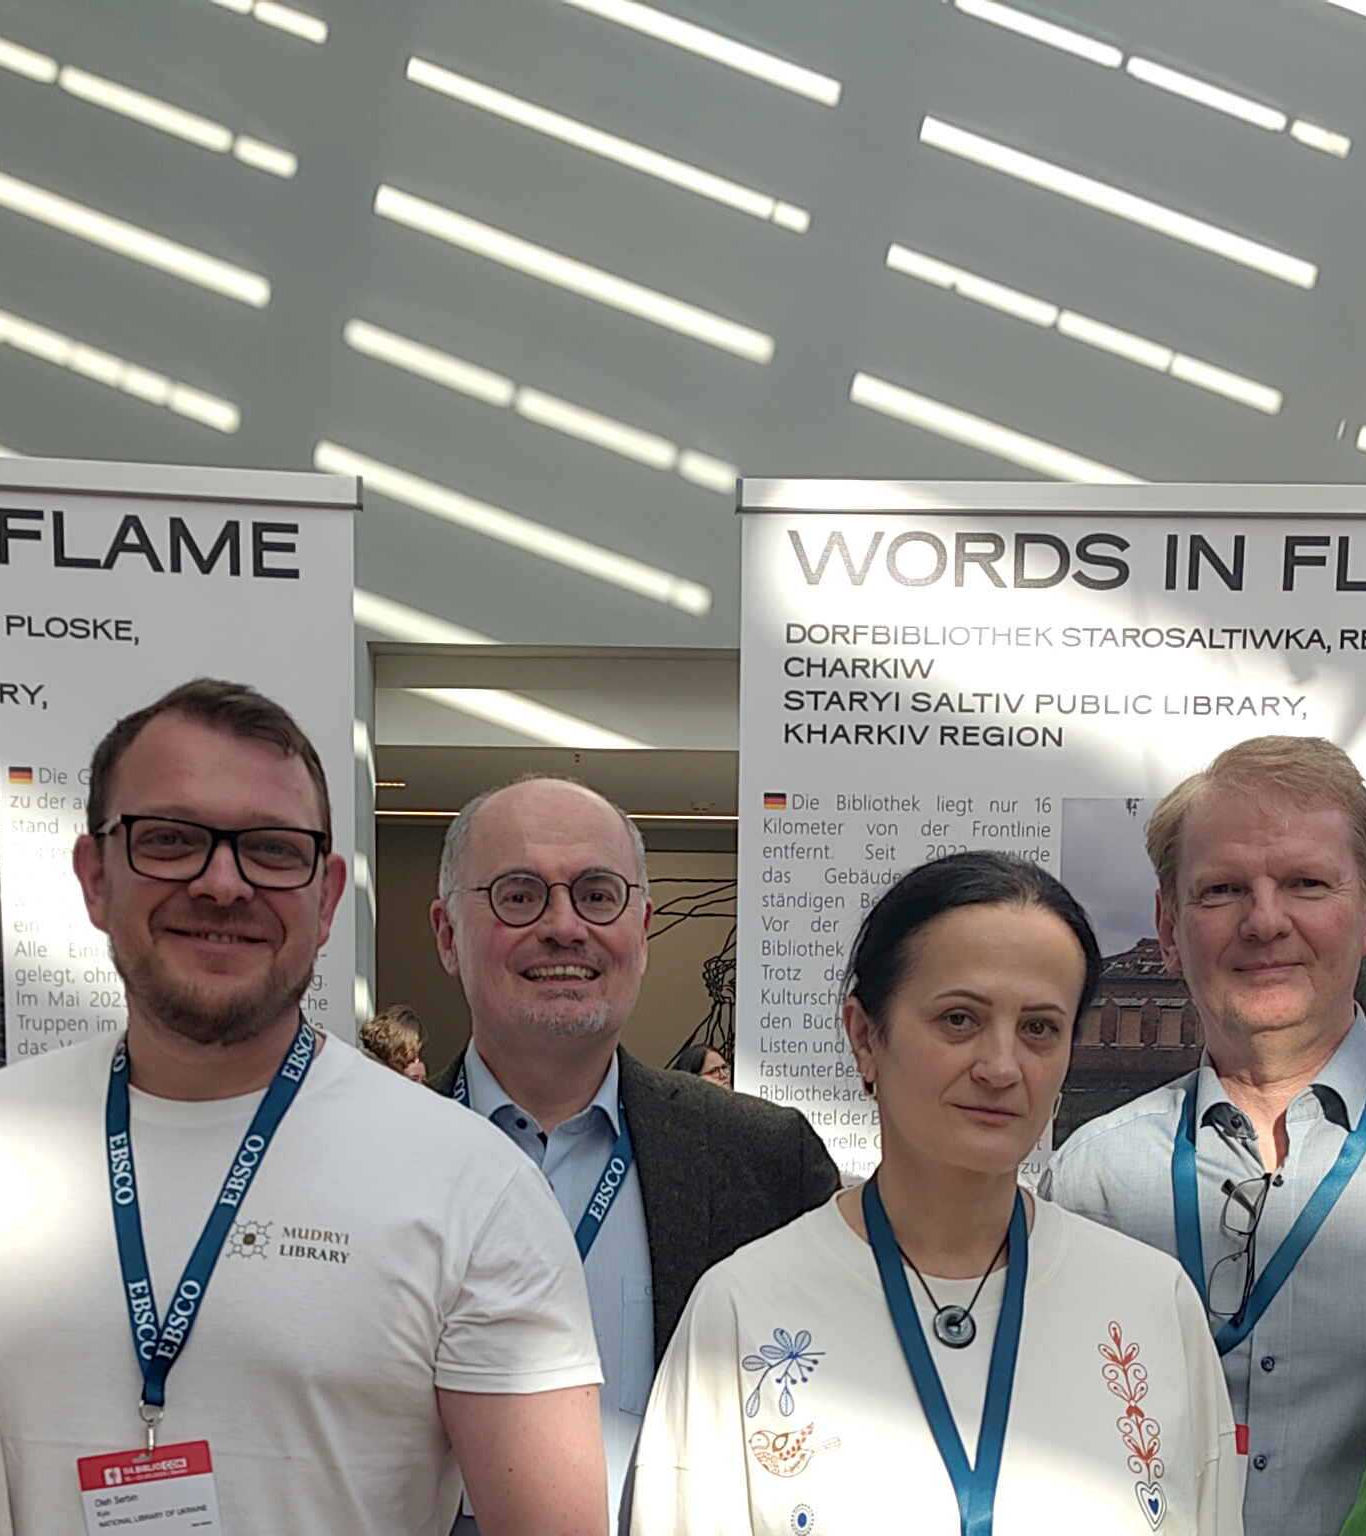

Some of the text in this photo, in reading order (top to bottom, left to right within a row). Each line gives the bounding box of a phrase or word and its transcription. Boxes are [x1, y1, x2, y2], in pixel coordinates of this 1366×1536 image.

[786, 530, 1131, 590] WORDS
[1165, 534, 1245, 591] IN
[4, 613, 140, 646] PLOSKE,
[785, 622, 1053, 648] DORFBIBLIOTHEK
[1061, 625, 1333, 654] STAROSALTIWKA,
[783, 656, 934, 679] CHARKIW
[783, 689, 1308, 721] STARYI SALTIV PUBLIC LIBRARY,
[783, 721, 1064, 748] KHARKIV REGION
[39, 767, 68, 784] Die
[9, 792, 66, 809] zu der
[792, 794, 1051, 816] Die Bibliothek liegt nur 16
[763, 819, 1051, 838] Kilometer von der Frontlinie
[865, 844, 896, 861] Seit
[762, 867, 791, 884] das
[762, 892, 845, 912] ständigen
[761, 916, 839, 933] Vor der
[15, 940, 47, 957] Alle
[762, 940, 844, 957] Bibliothek
[15, 965, 75, 987] gelegt,
[761, 964, 801, 981] Trotz
[16, 991, 79, 1007] Im Mai
[16, 1014, 117, 1035] Truppen im
[760, 1013, 791, 1030] den
[18, 1038, 48, 1055] das
[281, 1023, 315, 1083] EBSCO
[760, 1037, 845, 1054] Listen und
[109, 1131, 135, 1206] EBSCO
[218, 1134, 265, 1209] EBSCO
[587, 1156, 626, 1223] EBSCO
[282, 1227, 350, 1245] MUDRYI
[279, 1244, 350, 1264] LIBRARY
[154, 1280, 201, 1361] EBSCO
